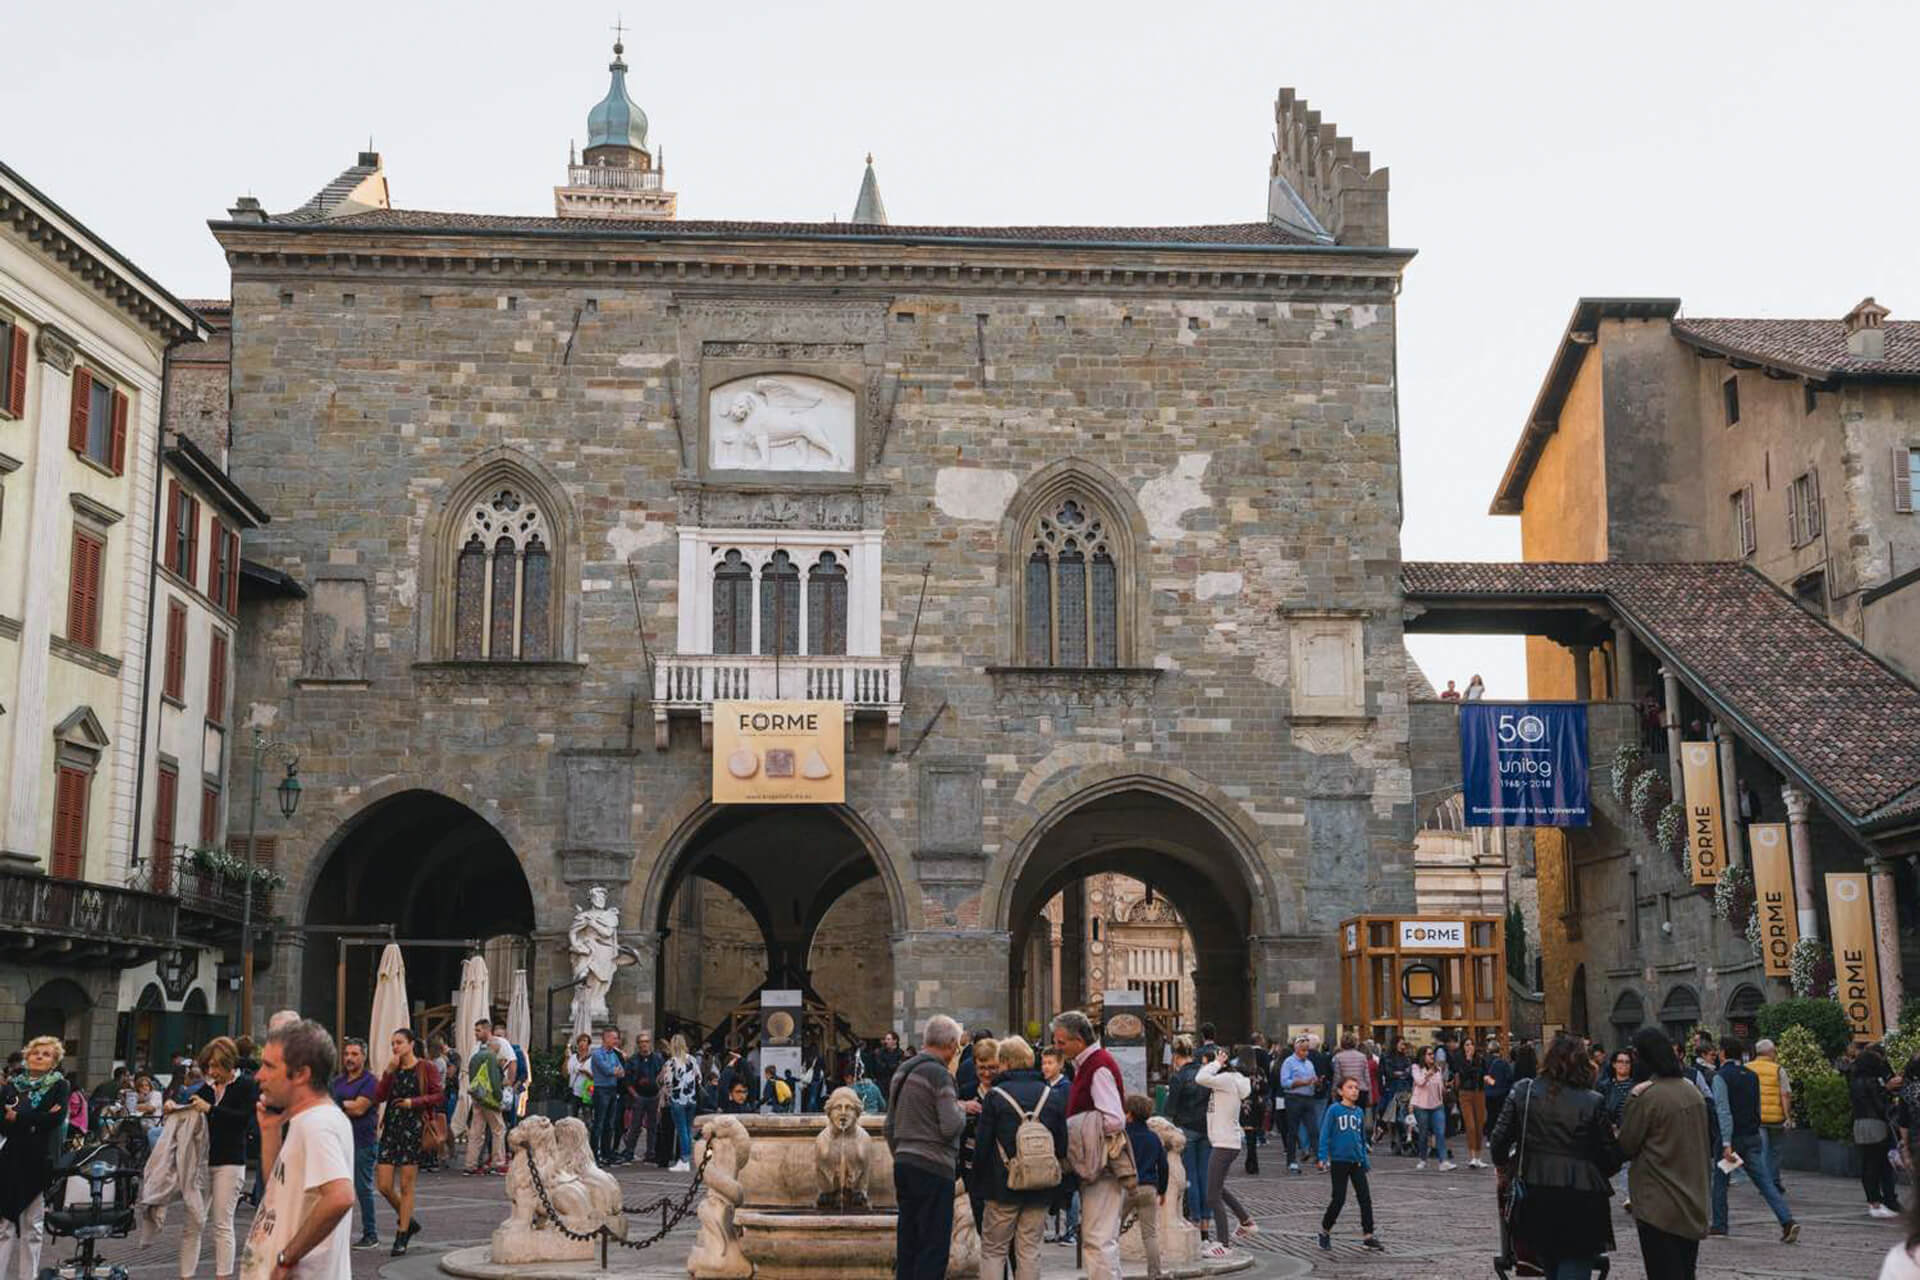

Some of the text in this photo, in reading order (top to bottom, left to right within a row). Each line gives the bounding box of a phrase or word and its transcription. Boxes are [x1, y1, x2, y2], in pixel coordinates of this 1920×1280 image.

[740, 713, 818, 731] FORME
[1499, 758, 1551, 777] unibg
[1695, 806, 1715, 878] FORME
[1405, 928, 1459, 941] FORME
[1766, 891, 1787, 969] FORME
[1844, 950, 1869, 1034] FORME
